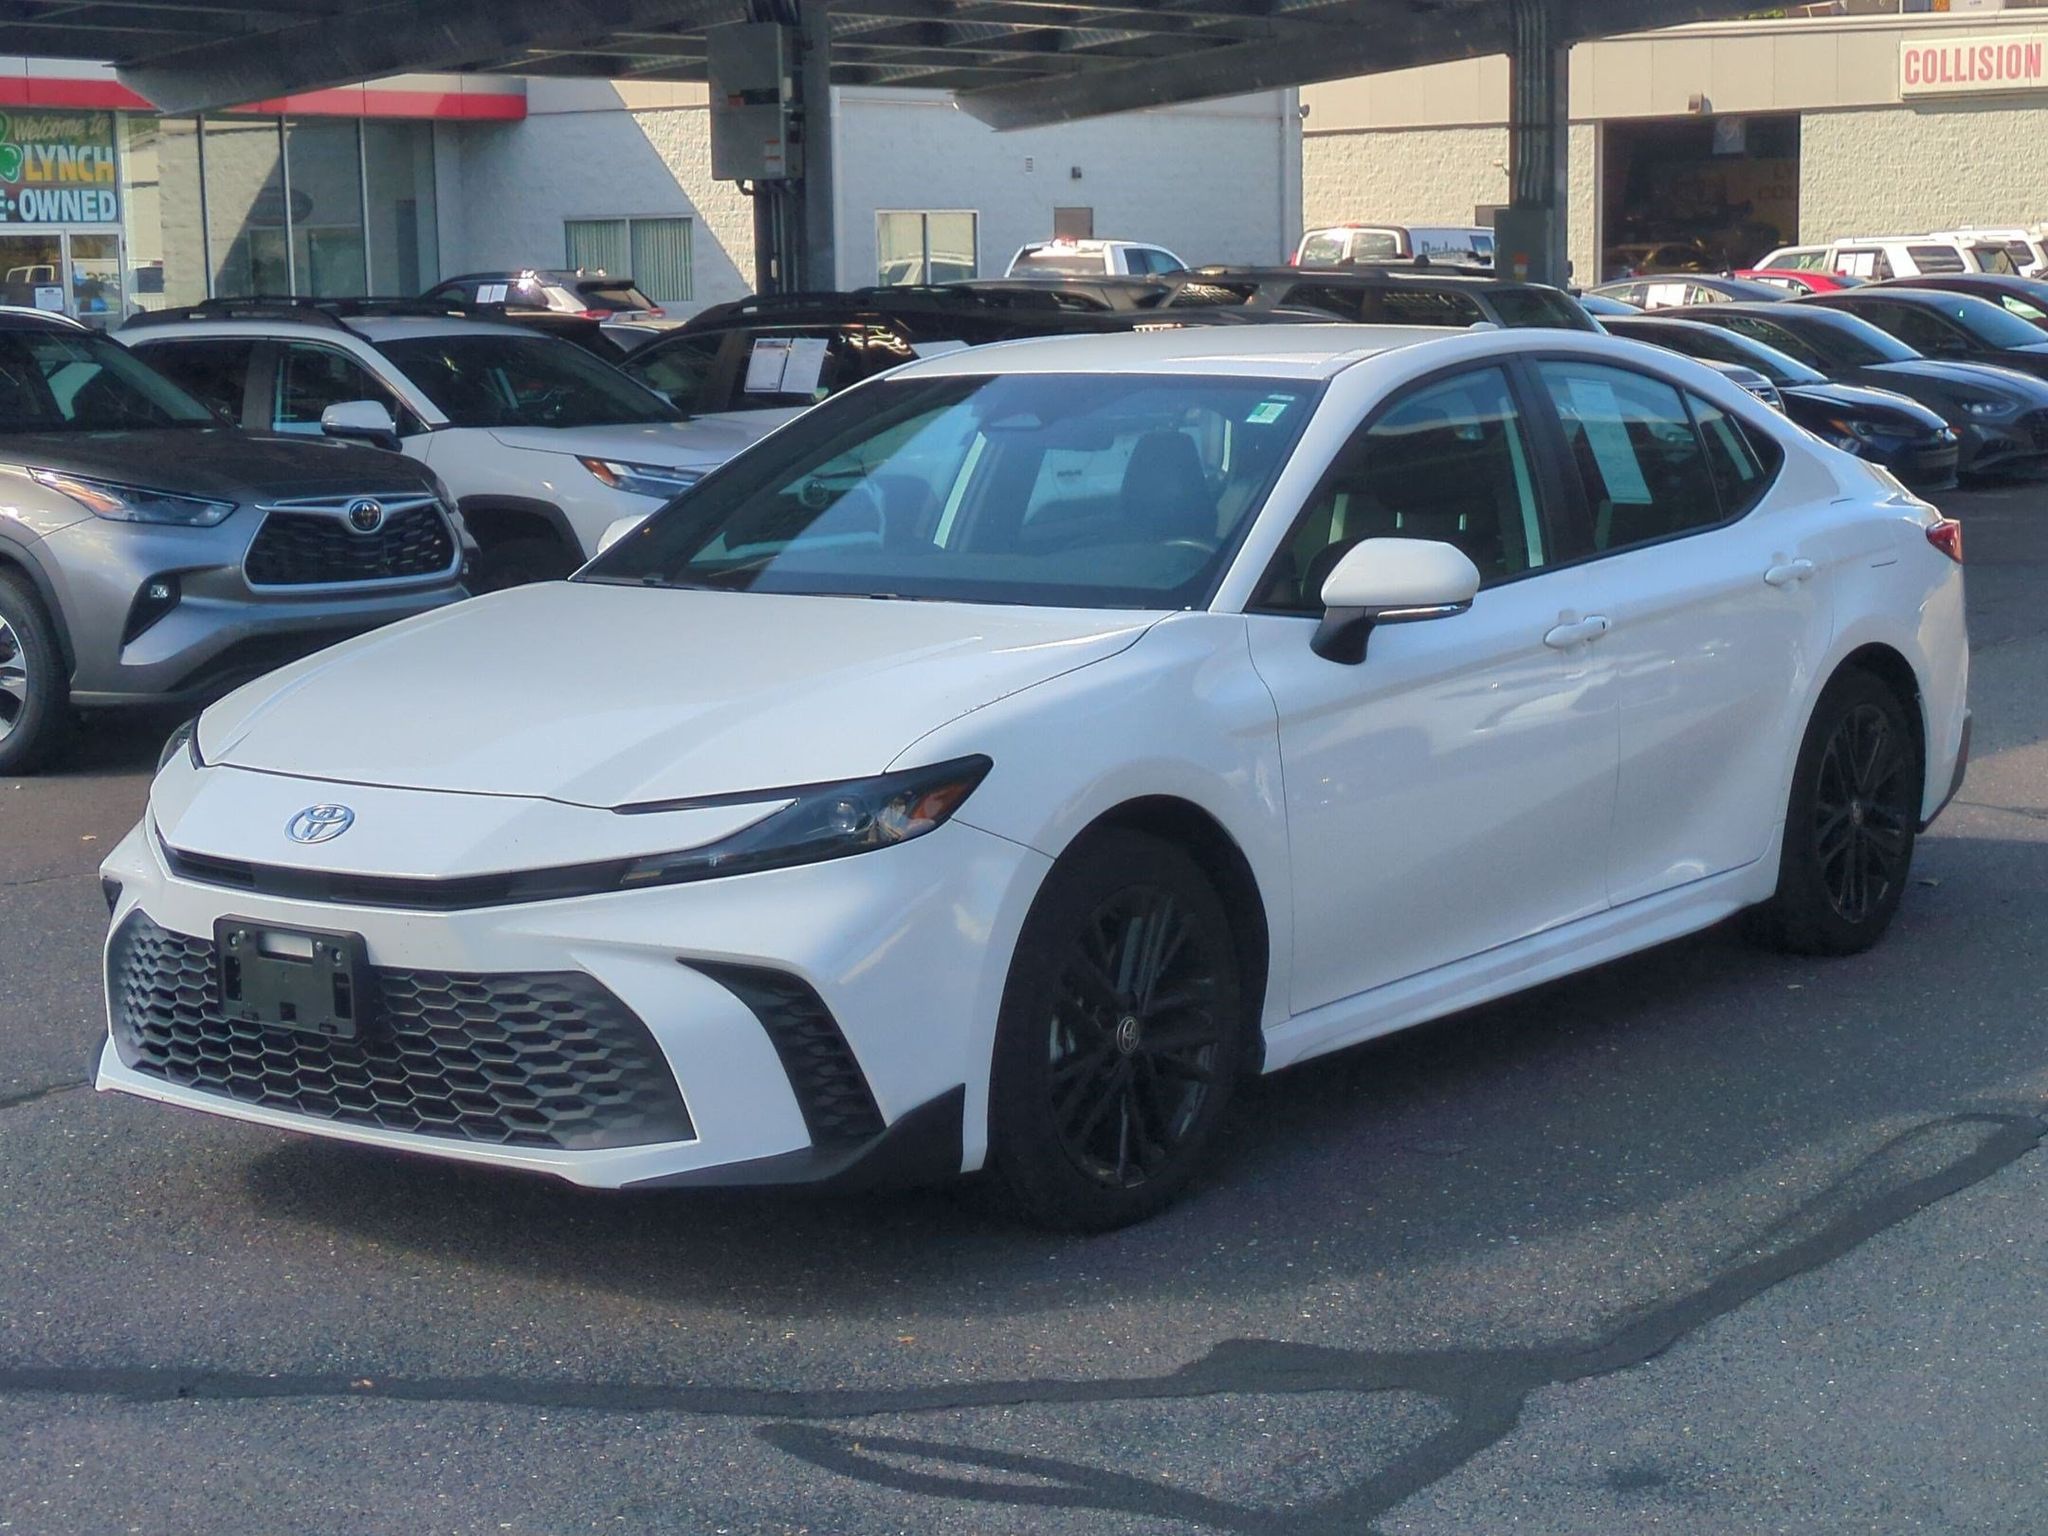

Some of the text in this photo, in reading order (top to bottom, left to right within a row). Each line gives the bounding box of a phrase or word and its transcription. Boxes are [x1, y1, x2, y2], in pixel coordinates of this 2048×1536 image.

[1905, 43, 2042, 85] COLLISION
[14, 115, 86, 141] Welcome
[23, 144, 116, 182] LYNCH
